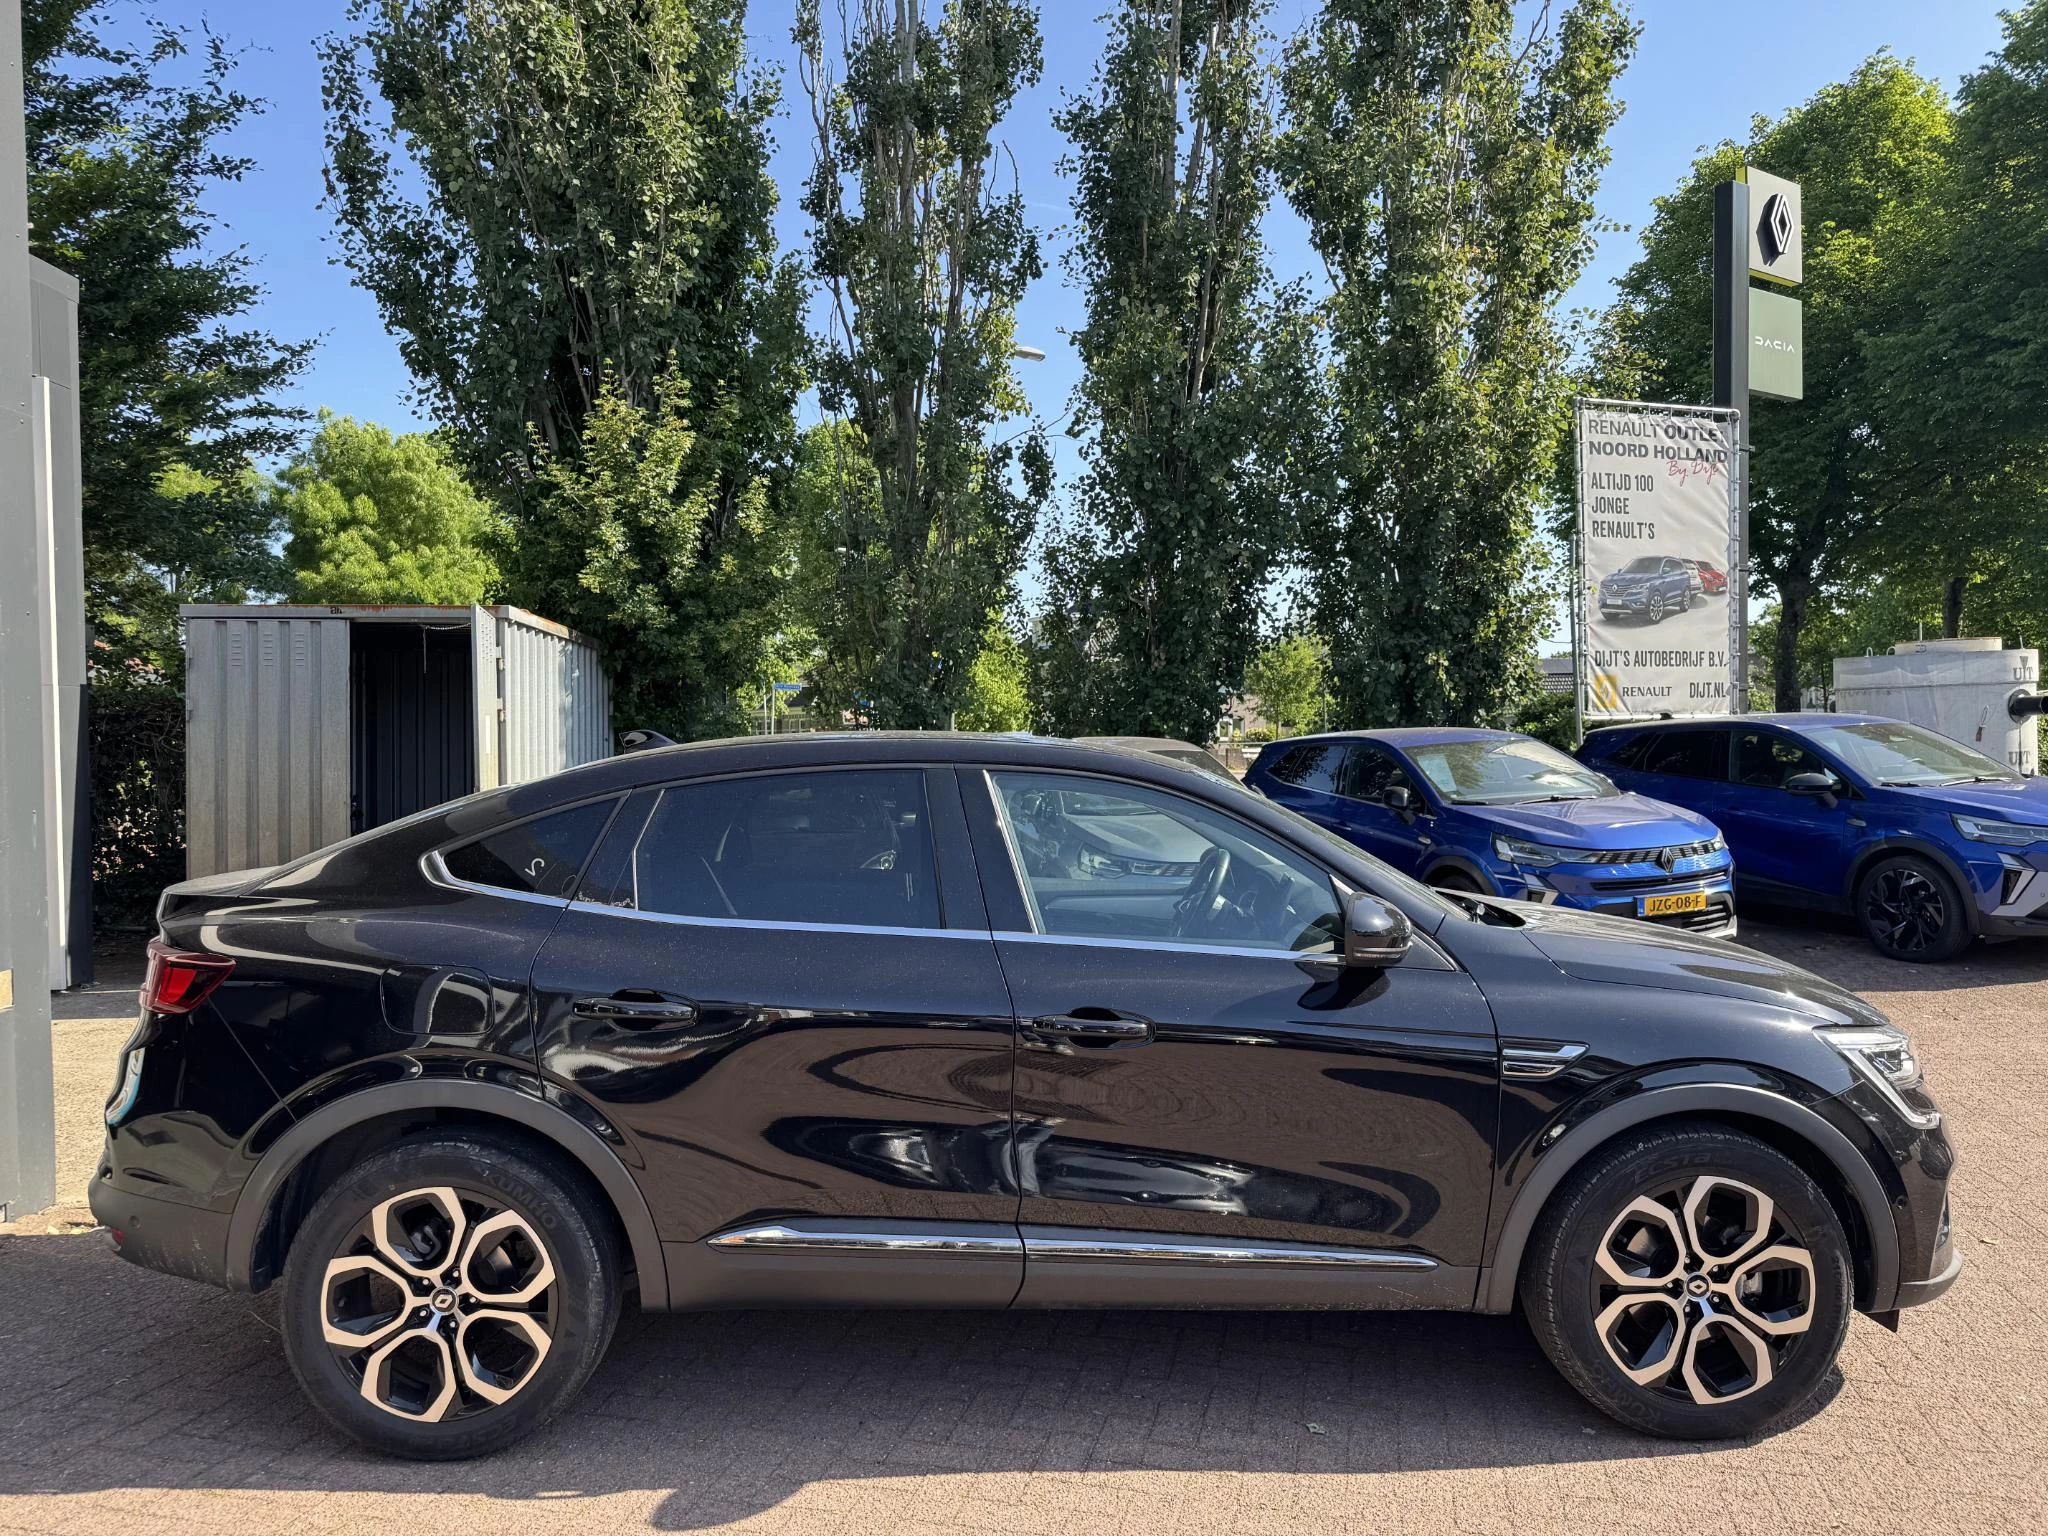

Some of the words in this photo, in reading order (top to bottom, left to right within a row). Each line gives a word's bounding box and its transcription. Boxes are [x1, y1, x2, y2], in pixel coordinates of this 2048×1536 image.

[1754, 336, 1795, 353] DACIA
[1588, 419, 1659, 438] RENAULT
[1589, 441, 1649, 458] NOORD
[1653, 445, 1728, 463] HOLLAND
[1591, 472, 1631, 491] ALTIJD
[1634, 475, 1654, 492] 100
[1591, 497, 1629, 514] JONGE
[1592, 520, 1655, 539] RENAULT'S
[1594, 650, 1630, 667] DIJT'S
[1633, 651, 1704, 667] AUTOBEDRIJF
[1708, 651, 1727, 667] B.V.
[2013, 667, 2033, 680] UIT
[1622, 686, 1672, 697] RENAULT
[1689, 682, 1726, 698] DIJT.NL
[1649, 894, 1702, 912] JZG-08-F
